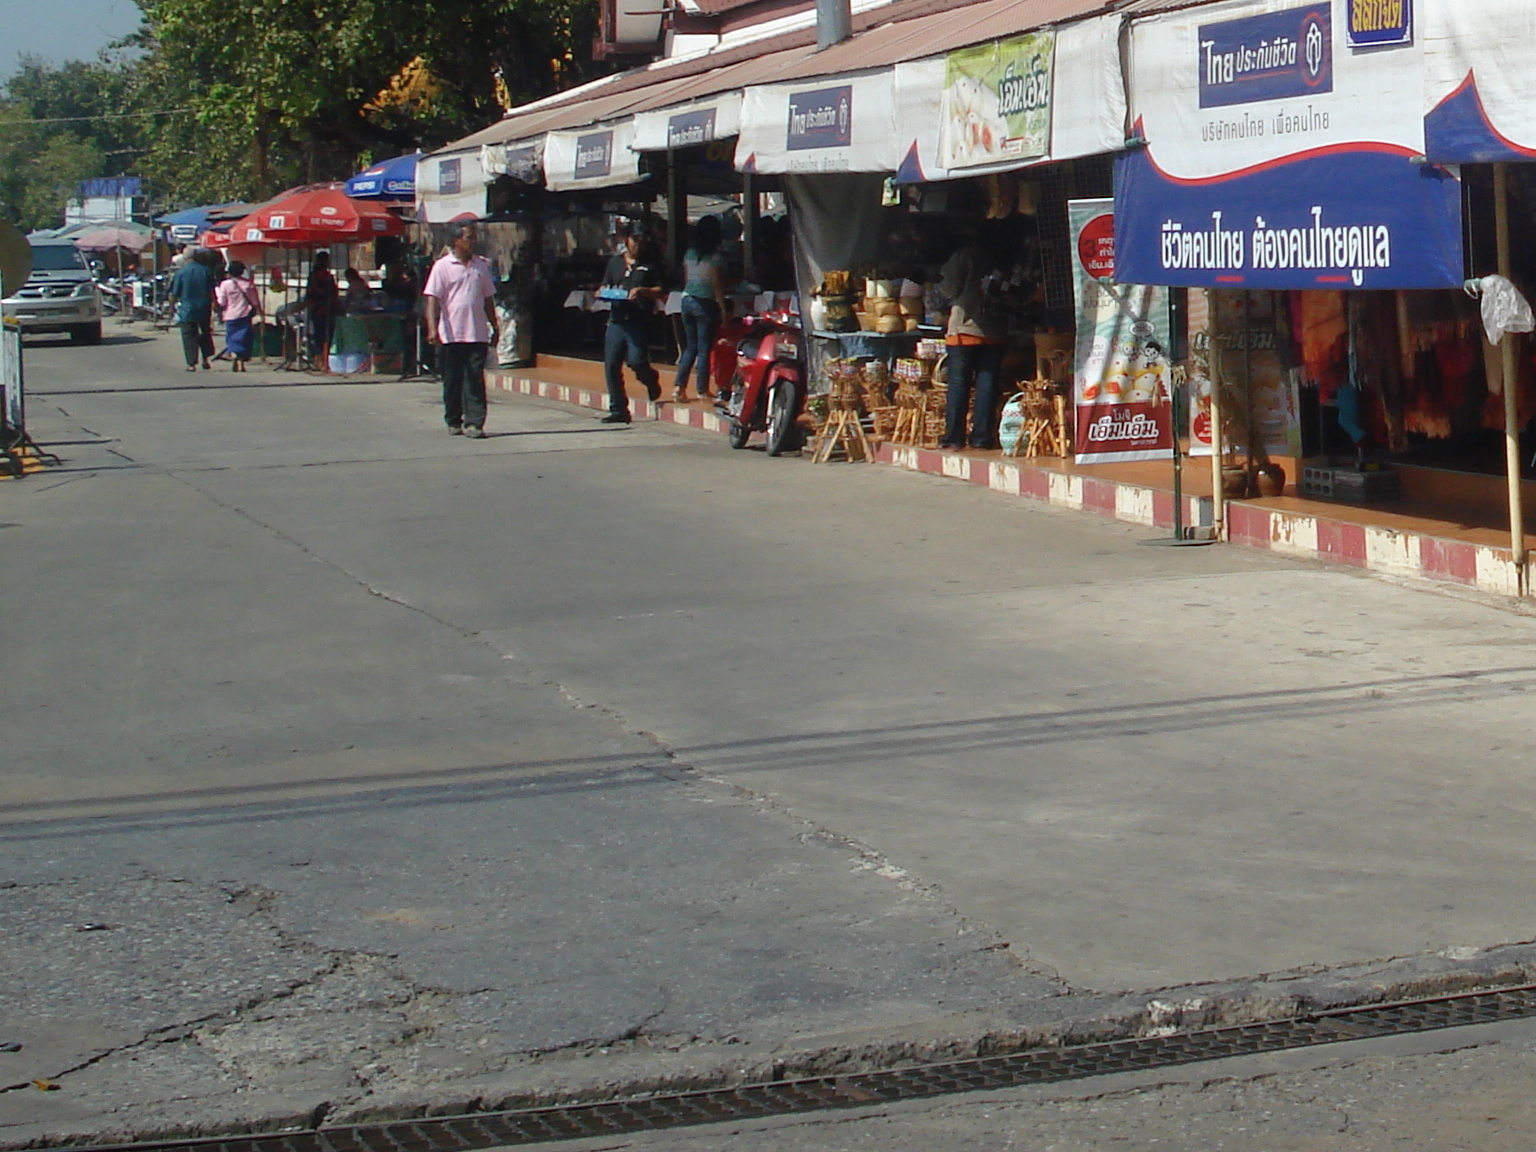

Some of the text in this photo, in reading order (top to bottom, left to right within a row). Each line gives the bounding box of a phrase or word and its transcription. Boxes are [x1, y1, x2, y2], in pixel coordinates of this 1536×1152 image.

[1202, 113, 1264, 142] บริษัทคนไทย
[1161, 206, 1390, 286] ชีวิตคนไทย ต้องคนไทยดูแล
